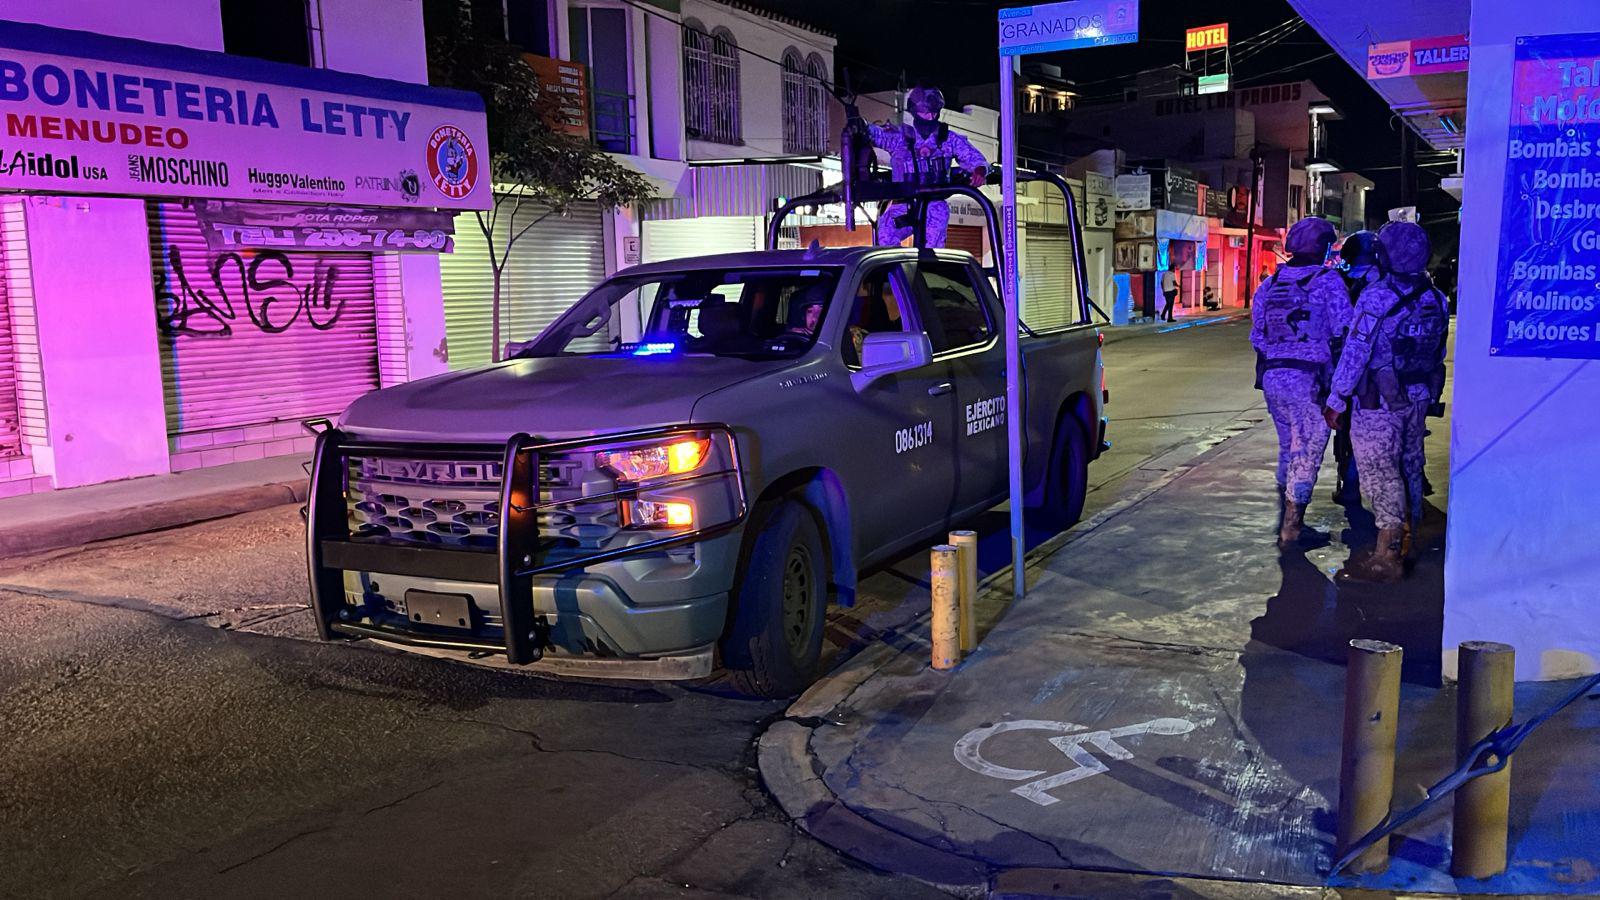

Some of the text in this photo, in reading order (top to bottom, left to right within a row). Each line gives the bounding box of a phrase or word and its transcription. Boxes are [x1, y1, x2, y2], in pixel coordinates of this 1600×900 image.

[1003, 14, 1102, 39] GRANADOS
[1186, 27, 1228, 49] HOTEL
[1413, 46, 1469, 66] TALLER
[0, 60, 412, 142] BONETERIA LETTY
[7, 113, 189, 150] MENUDEO
[430, 127, 474, 156] BONETERIA
[1509, 138, 1592, 159] Bombas
[83, 166, 108, 181] USA
[128, 154, 140, 182] JEANS
[139, 155, 229, 188] MOSCHINO
[433, 173, 472, 196] LETTY
[332, 213, 379, 224] ROPER
[1513, 260, 1596, 281] Bombas
[1515, 290, 1595, 311] Molinos
[1507, 320, 1590, 342] Motores
[966, 395, 1006, 423] EJÉRCITO
[966, 413, 1005, 437] MEXICANO
[895, 420, 933, 454] 0861314
